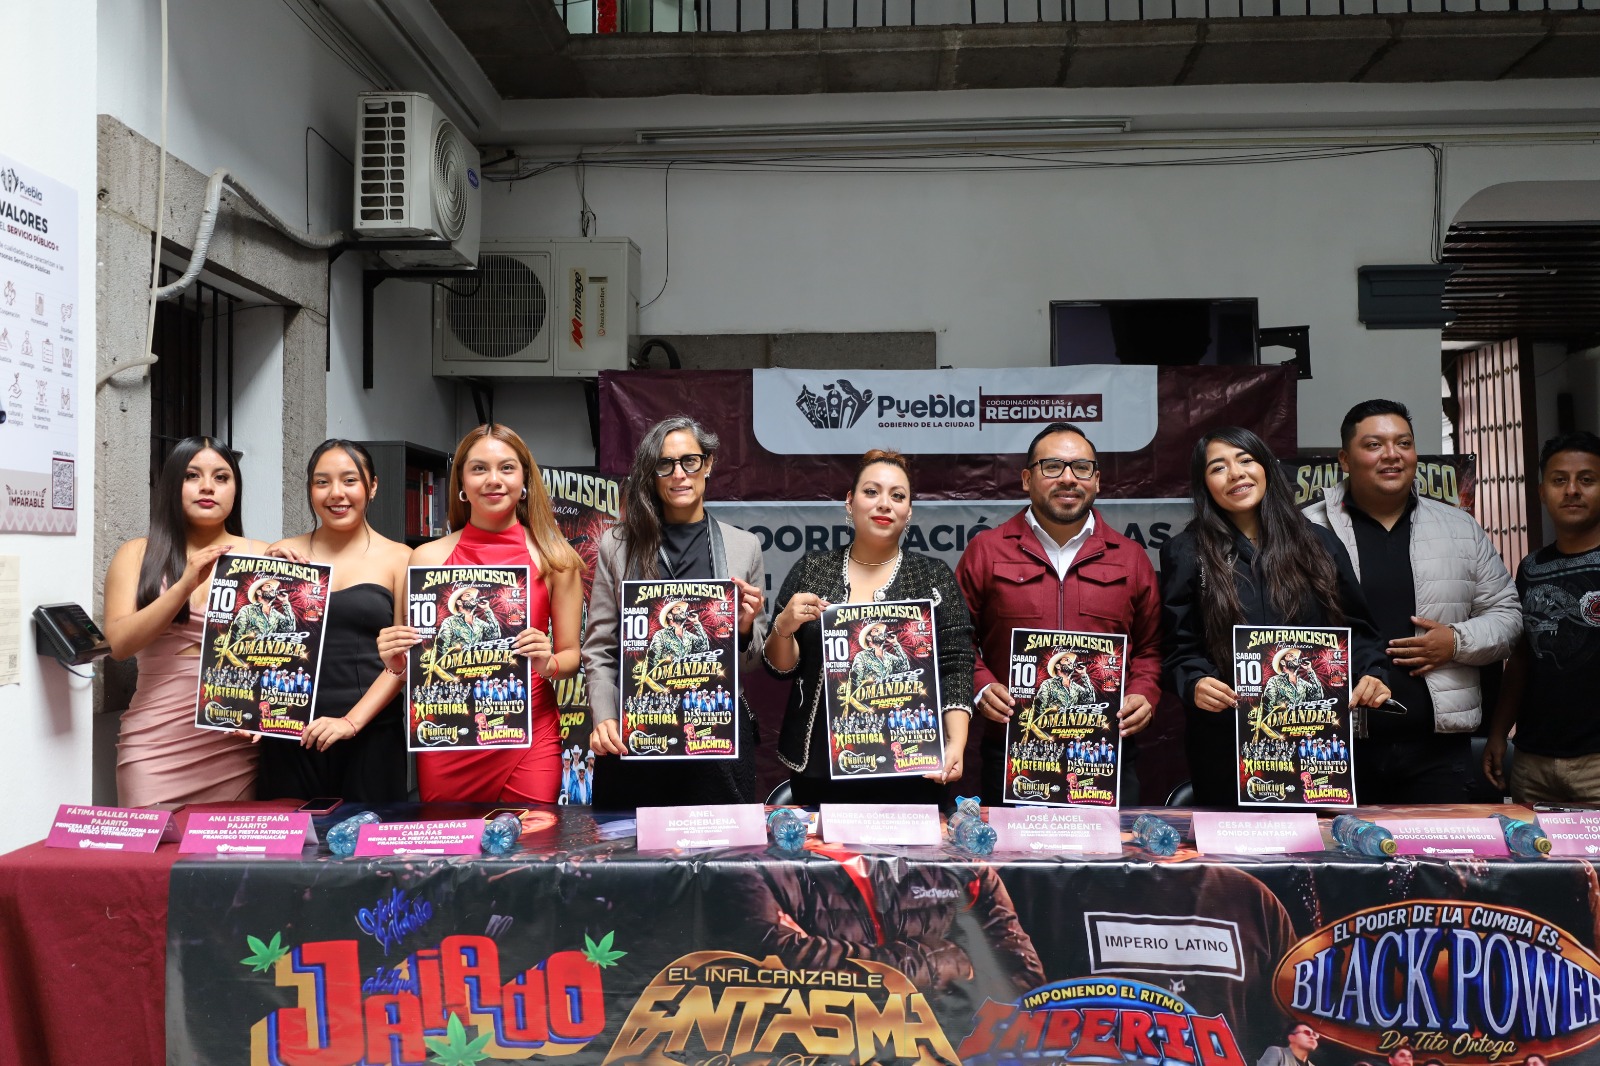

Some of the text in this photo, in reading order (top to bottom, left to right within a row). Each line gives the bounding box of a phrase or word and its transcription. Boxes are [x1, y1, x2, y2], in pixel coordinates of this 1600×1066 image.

[20, 181, 42, 201] Puebla
[0, 199, 48, 234] VALORES
[7, 224, 32, 242] SERVICIO
[573, 271, 583, 320] mirage
[877, 394, 975, 418] Puebla
[985, 402, 1098, 420] REGIDURÍAS
[986, 398, 1040, 406] COORDINACIÓN
[9, 496, 44, 508] IMPARABLE
[542, 468, 620, 520] ANCISCO
[228, 559, 320, 584] SAN FRANCISCO
[423, 569, 517, 589] SAN FRANCISCO
[212, 587, 236, 612] 10
[636, 583, 726, 602] SAN FRANCISCO
[208, 612, 233, 620] OCTUBRE
[411, 602, 436, 627] 10
[835, 606, 922, 625] SAN FRANCISCO
[624, 616, 648, 640] 10
[1026, 635, 1114, 655] SAN FRANCISCO
[1248, 630, 1338, 648] SAN FRANCISCO
[825, 638, 849, 661] 10
[1012, 663, 1036, 687] 10
[1237, 660, 1261, 685] 10
[1011, 687, 1035, 695] OCTUBRE
[262, 718, 303, 731] TALACHITAS
[479, 729, 523, 740] TALACHITAS
[688, 739, 730, 750] TALACHITAS
[896, 757, 937, 768] TALACHITAS
[1070, 790, 1112, 800] TALACHITAS
[1305, 788, 1347, 799] TALACHITAS
[67, 807, 95, 816] FÁTIMA
[96, 810, 128, 819] GALILEA
[257, 814, 289, 822] ESPAÑA
[689, 810, 714, 818] ANEL
[1025, 814, 1083, 822] JOSÉ ÁNGEL
[91, 818, 128, 827] PAJARITO
[378, 823, 424, 831] ESTEFANÍA
[669, 818, 736, 827] NOCHEBUENA
[1254, 821, 1294, 829] JUÁREZ
[1333, 924, 1351, 944] EL
[1355, 909, 1406, 935] PODER
[1412, 905, 1434, 923] DE
[1441, 906, 1463, 924] LA
[1471, 906, 1534, 938] CUMBIA
[1104, 935, 1229, 953] IMPERIO LATINO
[668, 967, 883, 988] EL INALCANZABLE
[1291, 927, 1441, 1028] BLACK
[1023, 984, 1185, 1014] IMPONIENDO EL RITMO
[1379, 1030, 1516, 1061] De Tito Ortega
